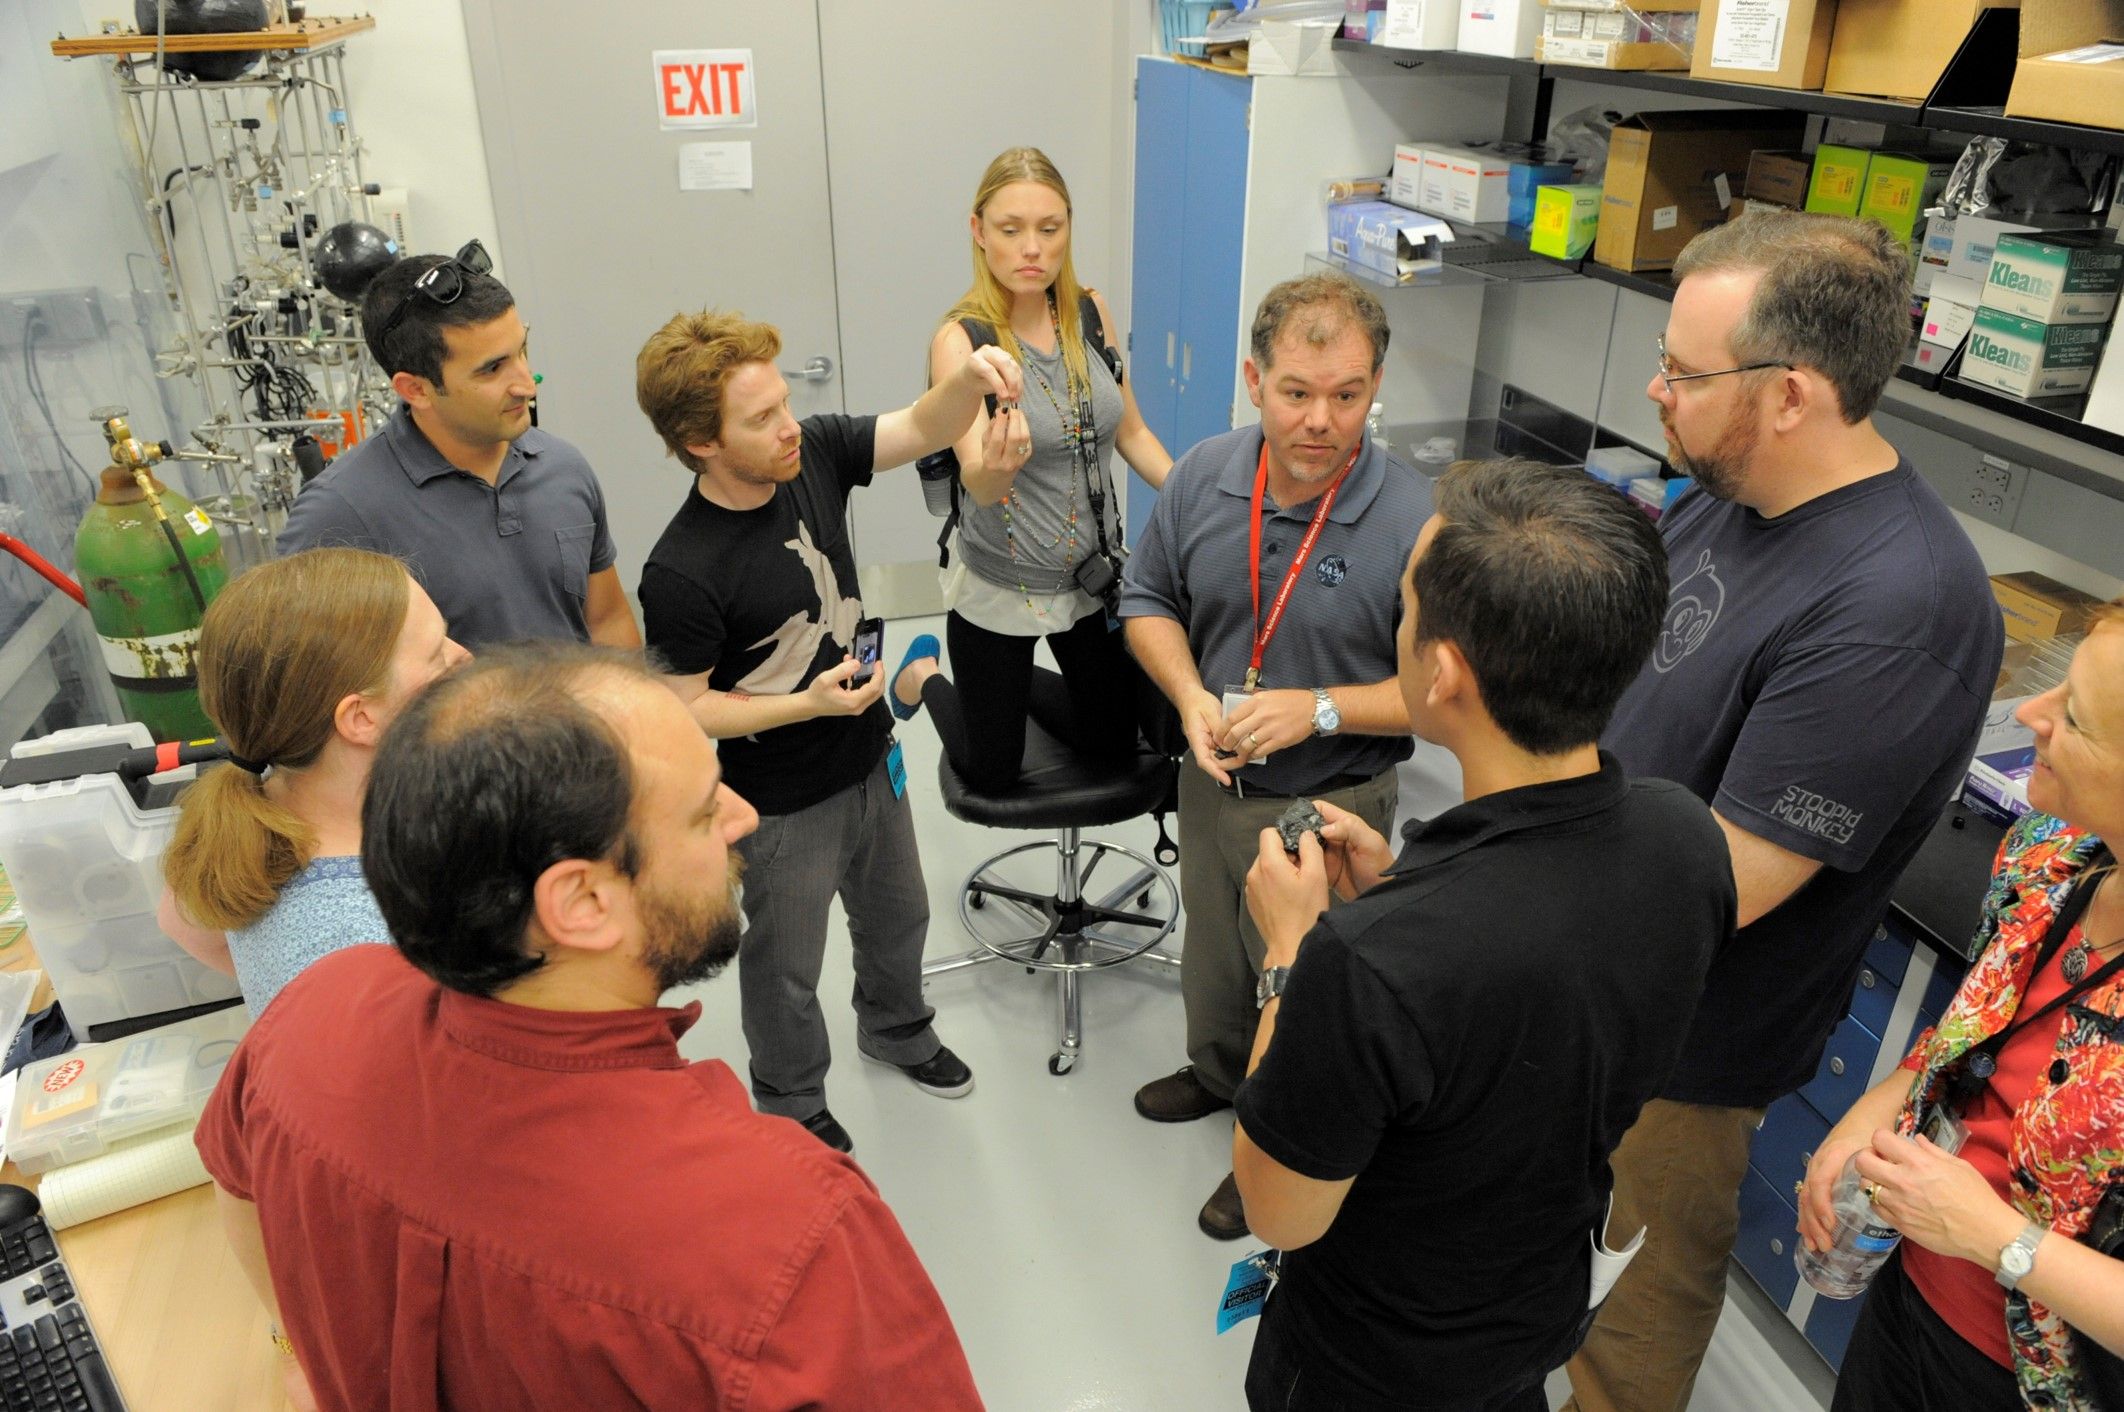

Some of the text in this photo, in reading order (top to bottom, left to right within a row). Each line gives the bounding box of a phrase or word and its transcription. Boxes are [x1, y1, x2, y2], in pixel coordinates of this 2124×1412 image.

[661, 63, 744, 116] EXIT
[1989, 261, 2053, 299] Kleans
[1969, 333, 2031, 371] Kleans
[1303, 523, 1320, 549] Science
[1315, 488, 1336, 523] Laboratory
[1318, 562, 1345, 580] NASA
[1266, 606, 1281, 631] Science
[1276, 571, 1297, 606] Laboratory
[1227, 1283, 1266, 1299] OFFICIAL
